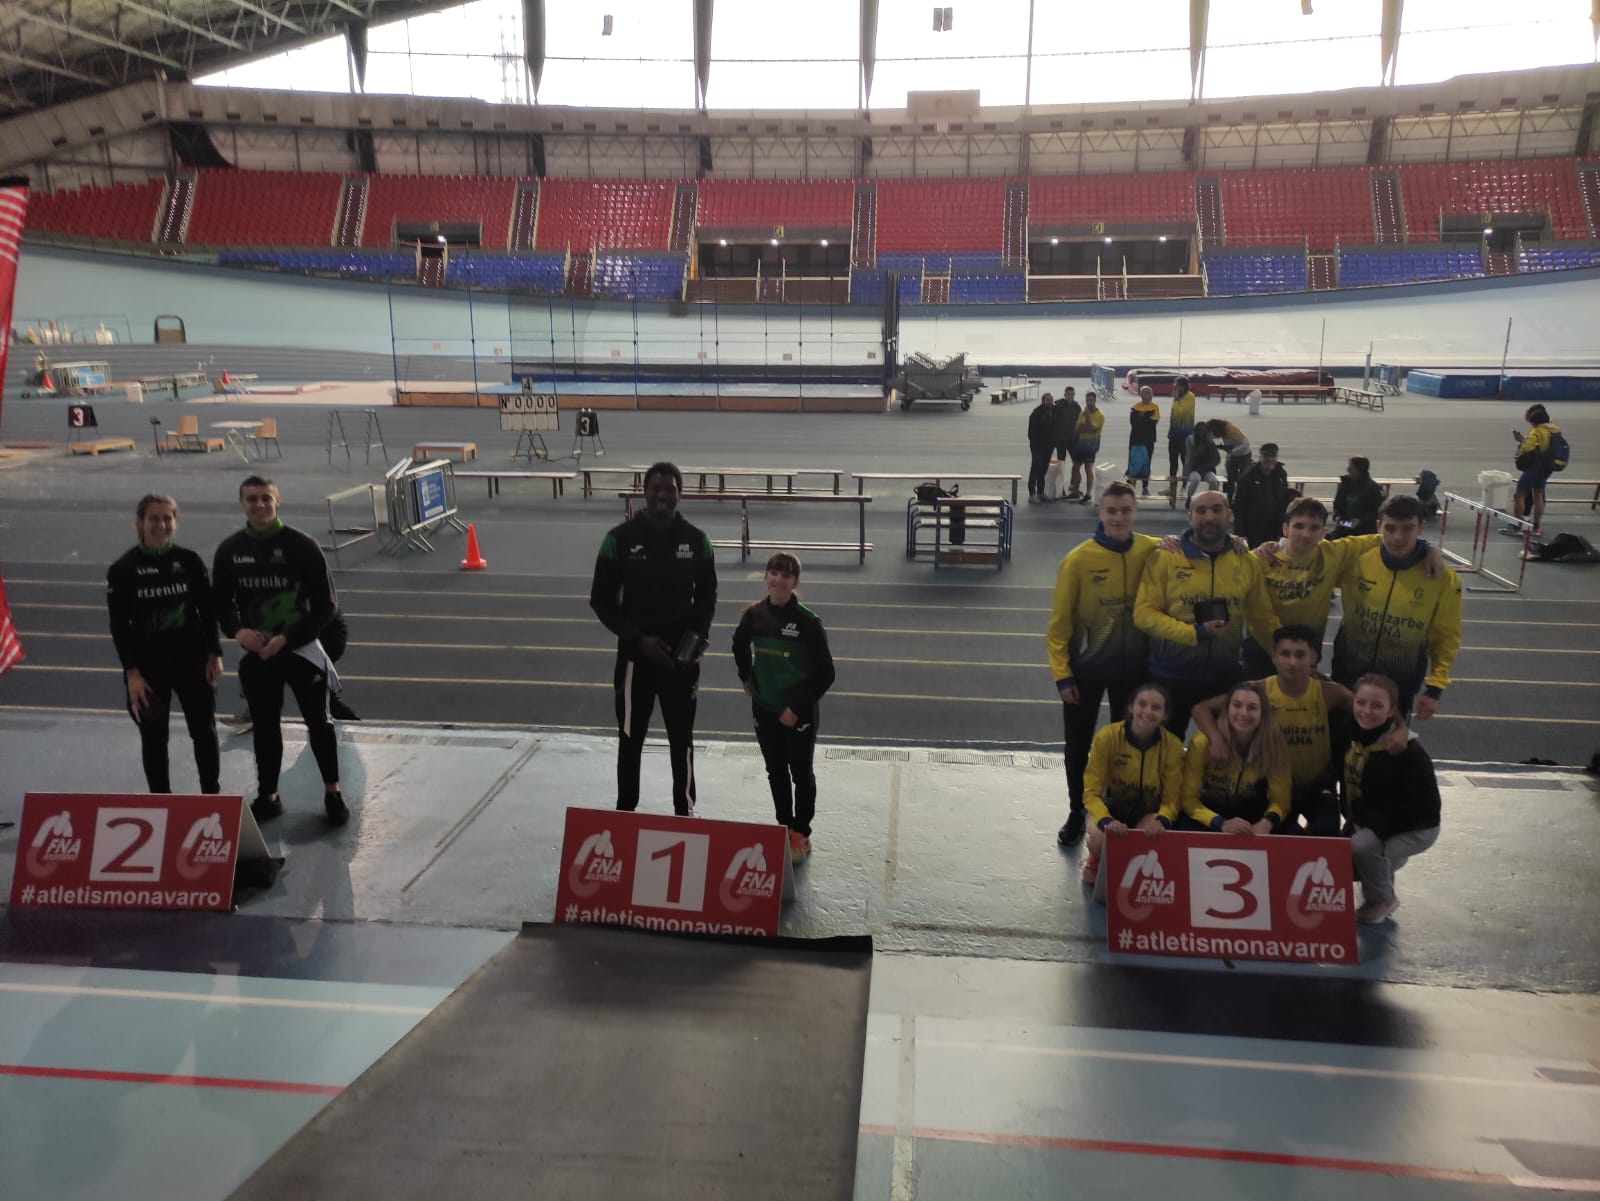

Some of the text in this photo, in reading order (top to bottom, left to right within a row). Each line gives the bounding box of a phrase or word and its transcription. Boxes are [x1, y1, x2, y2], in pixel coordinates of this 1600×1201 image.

[72, 407, 85, 427] 3
[581, 416, 590, 435] 3
[46, 837, 82, 855] FNA
[100, 816, 155, 874] 2
[195, 839, 232, 856] FNA
[587, 857, 623, 876] FNA
[651, 840, 686, 904] 1
[740, 871, 776, 891] FNA
[1137, 879, 1175, 898] FNA
[1205, 858, 1259, 920] 3
[21, 885, 221, 906] #atletismonavarro
[1306, 886, 1347, 906] FNA
[1119, 929, 1346, 960] #atletismonavarro
